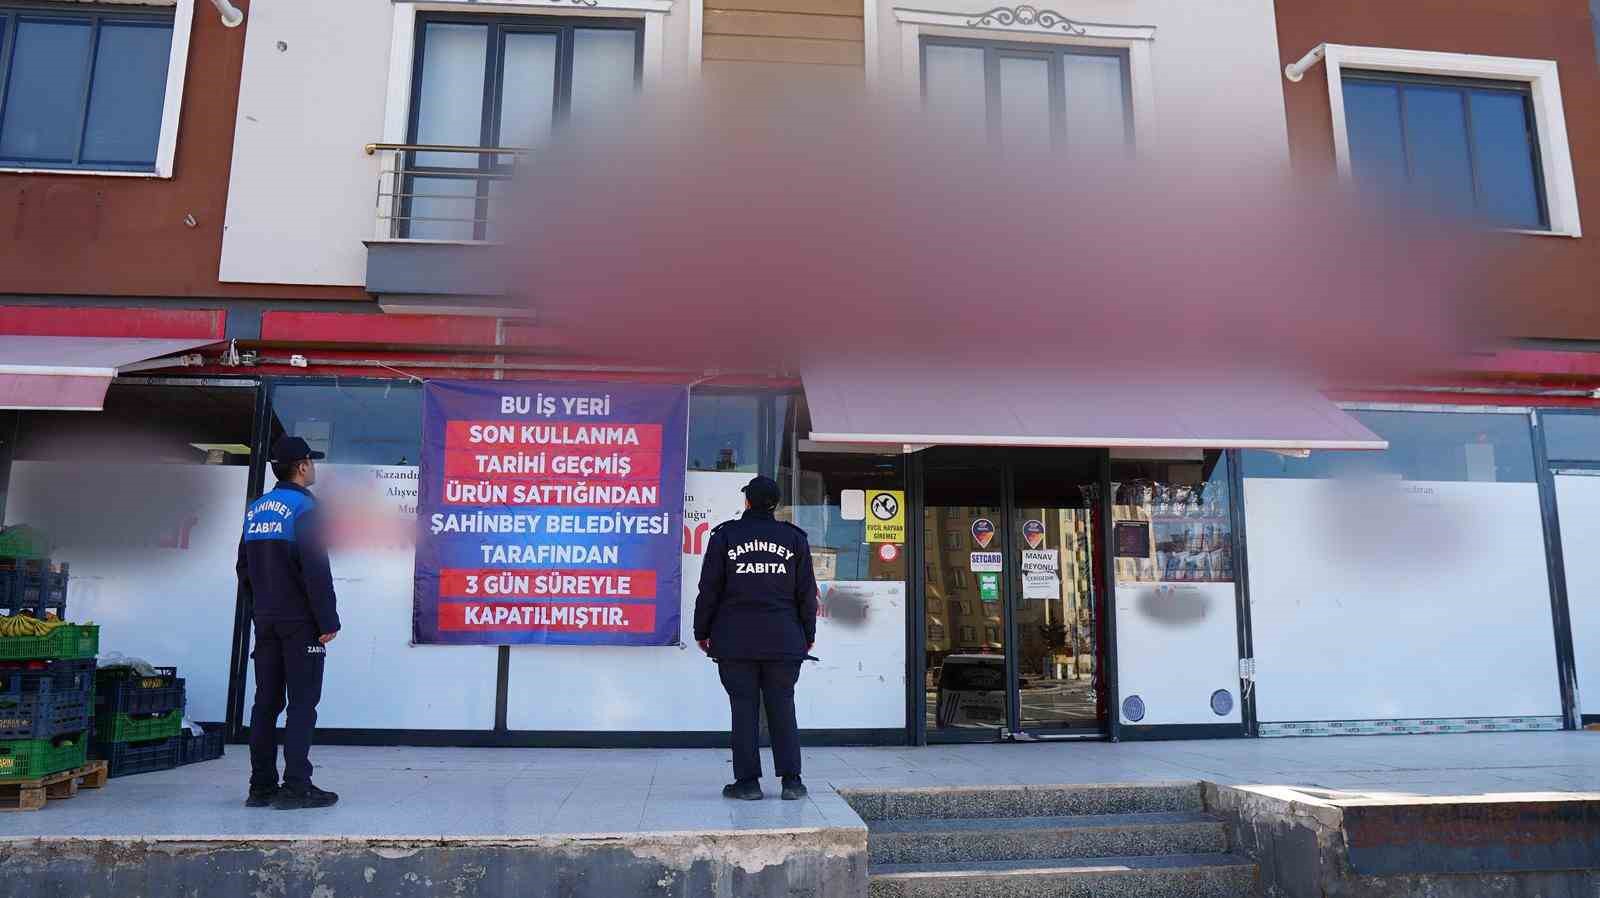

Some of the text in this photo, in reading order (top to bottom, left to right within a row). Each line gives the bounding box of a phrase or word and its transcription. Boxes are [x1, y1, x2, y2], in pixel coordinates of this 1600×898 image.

[500, 393, 610, 417] BU İŞ YERİ
[469, 425, 640, 445] SON KULLANMA
[475, 452, 631, 477] TARİHİ GEÇMİŞ
[446, 480, 657, 504] ÜRÜN SATTIĞINDAN
[248, 521, 283, 534] ZABITA
[431, 510, 669, 535] ŞAHİNBEY BELEDİYESİ
[481, 544, 618, 564] TARAFINDAN
[727, 538, 794, 561] ŞAHİNBEY
[971, 554, 1001, 563] SETCARD
[1025, 552, 1053, 561] MANAV
[735, 562, 787, 574] ZABITA
[465, 572, 631, 595] 3 GÜN SÜREYLE
[464, 606, 629, 629] KAPATILMIŞTIR.
